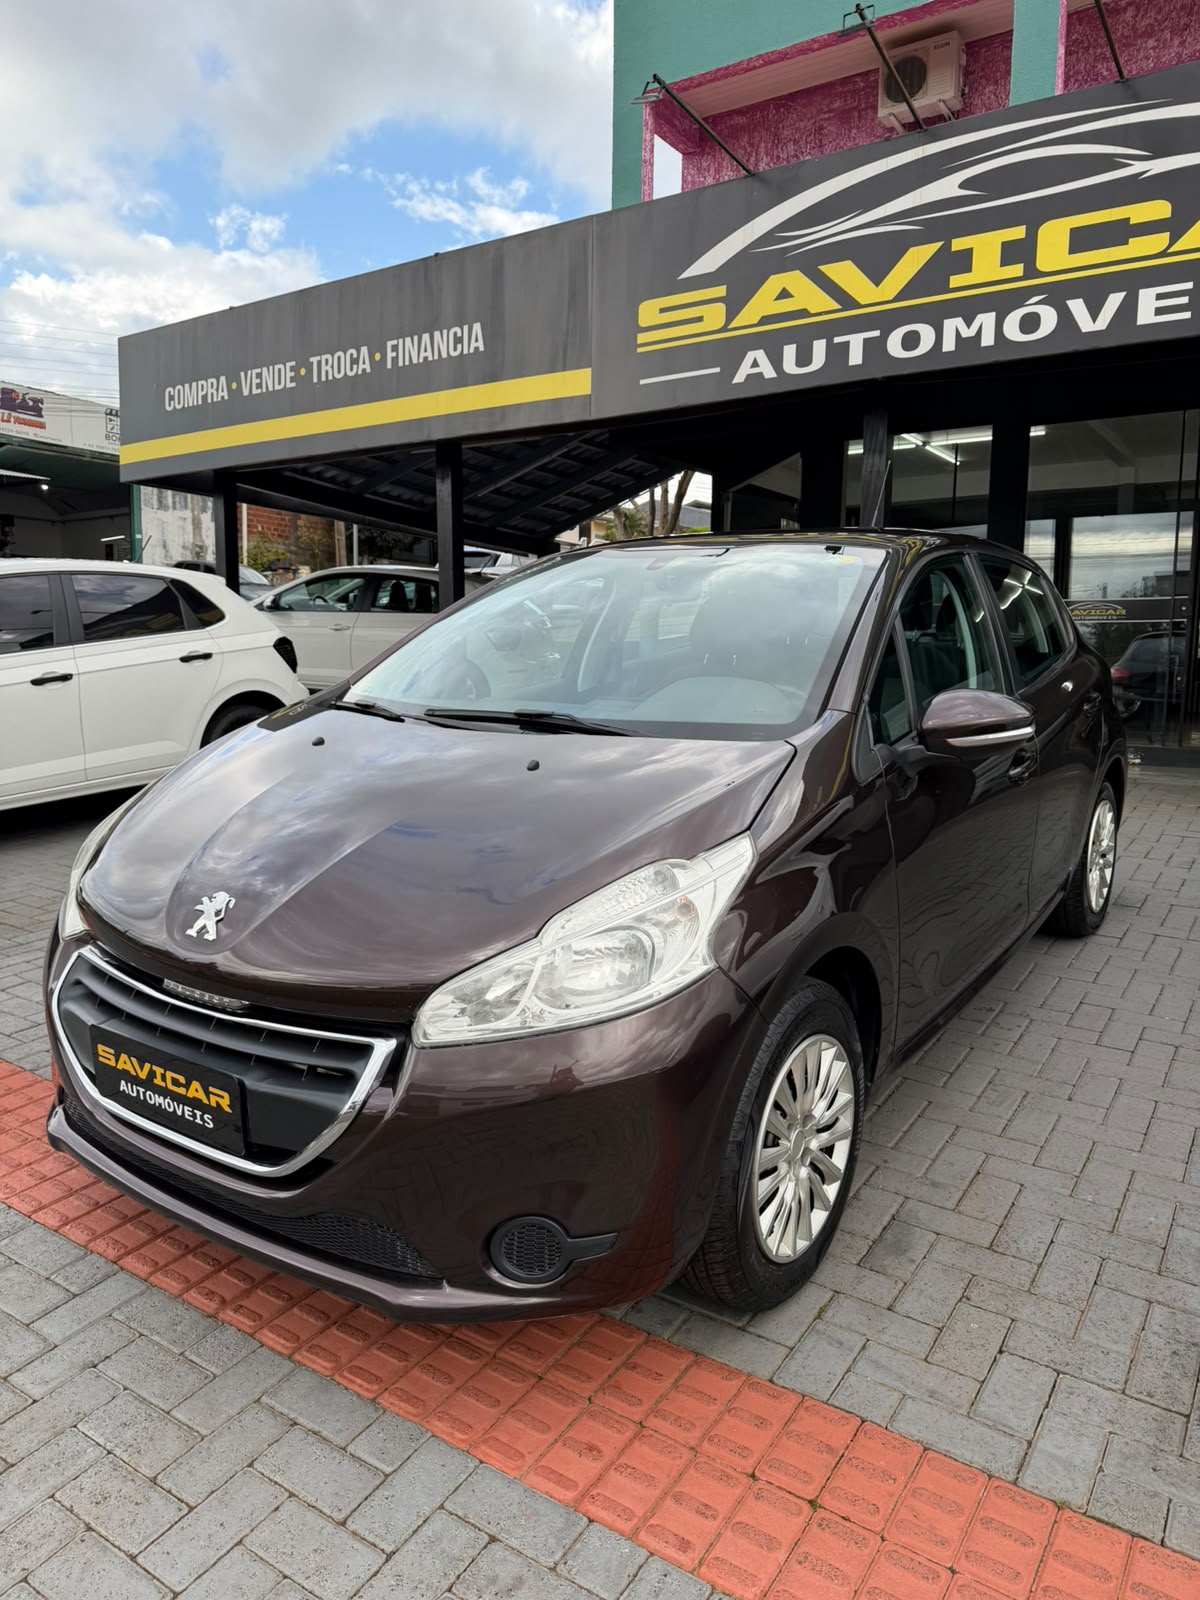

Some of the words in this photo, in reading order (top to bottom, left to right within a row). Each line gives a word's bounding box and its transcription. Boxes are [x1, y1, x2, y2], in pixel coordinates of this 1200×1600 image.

[637, 199, 1200, 345] SAVIC
[164, 375, 229, 411] COMPRA
[240, 361, 296, 396] VENDE
[309, 346, 371, 383] TROCA
[386, 322, 485, 369] FINANCIA
[732, 281, 1194, 384] AUTOMÓVE
[105, 433, 120, 442] BO
[97, 1043, 232, 1113] SAVICAR
[120, 1080, 214, 1129] AUTOMÓVEIS
